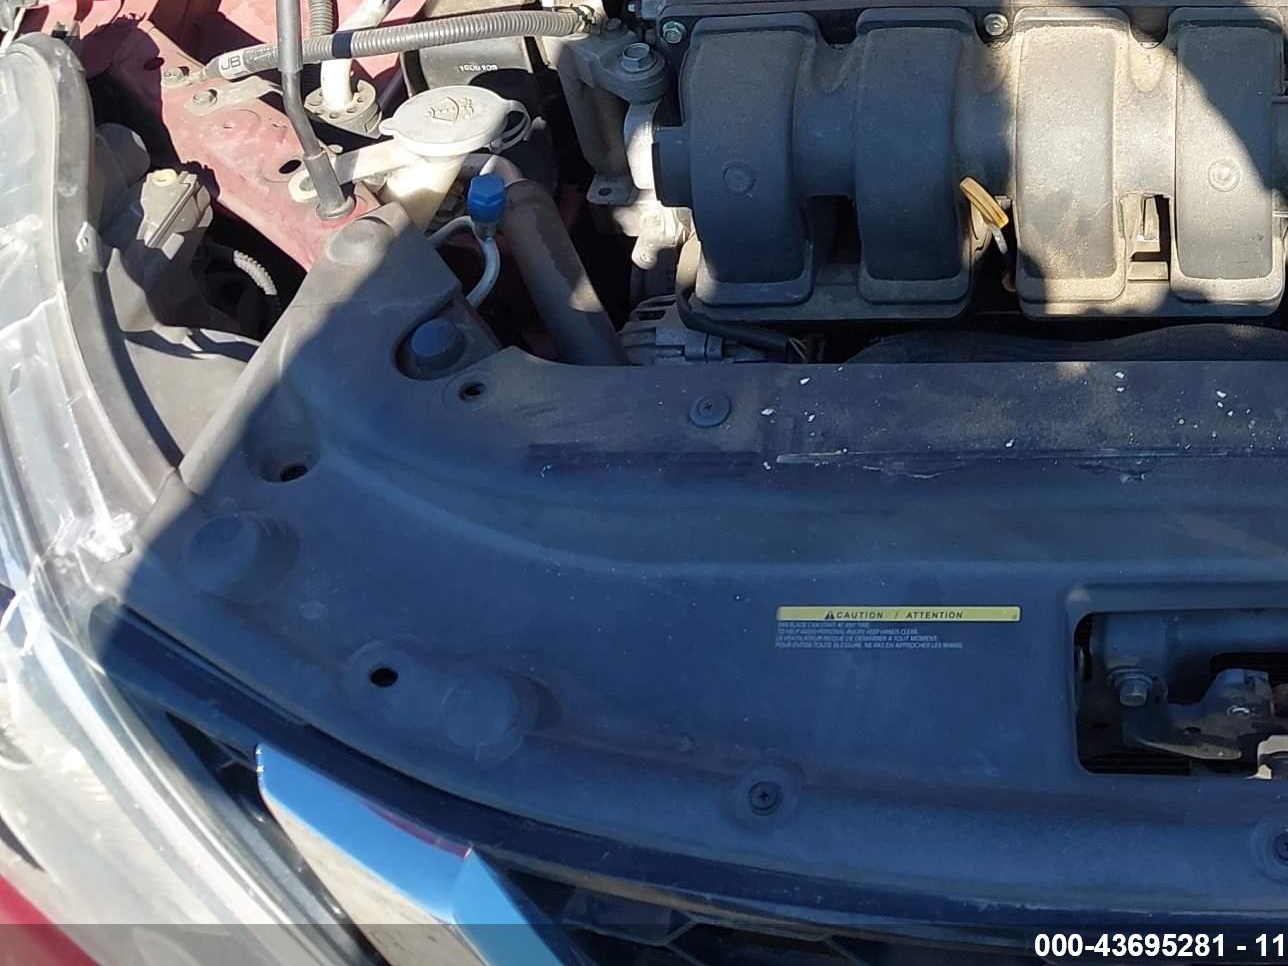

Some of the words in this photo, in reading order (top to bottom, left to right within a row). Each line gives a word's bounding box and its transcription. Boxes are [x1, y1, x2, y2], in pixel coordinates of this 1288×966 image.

[221, 55, 242, 71] JB
[836, 611, 883, 619] CAUTION
[906, 611, 963, 619] ATTENTION
